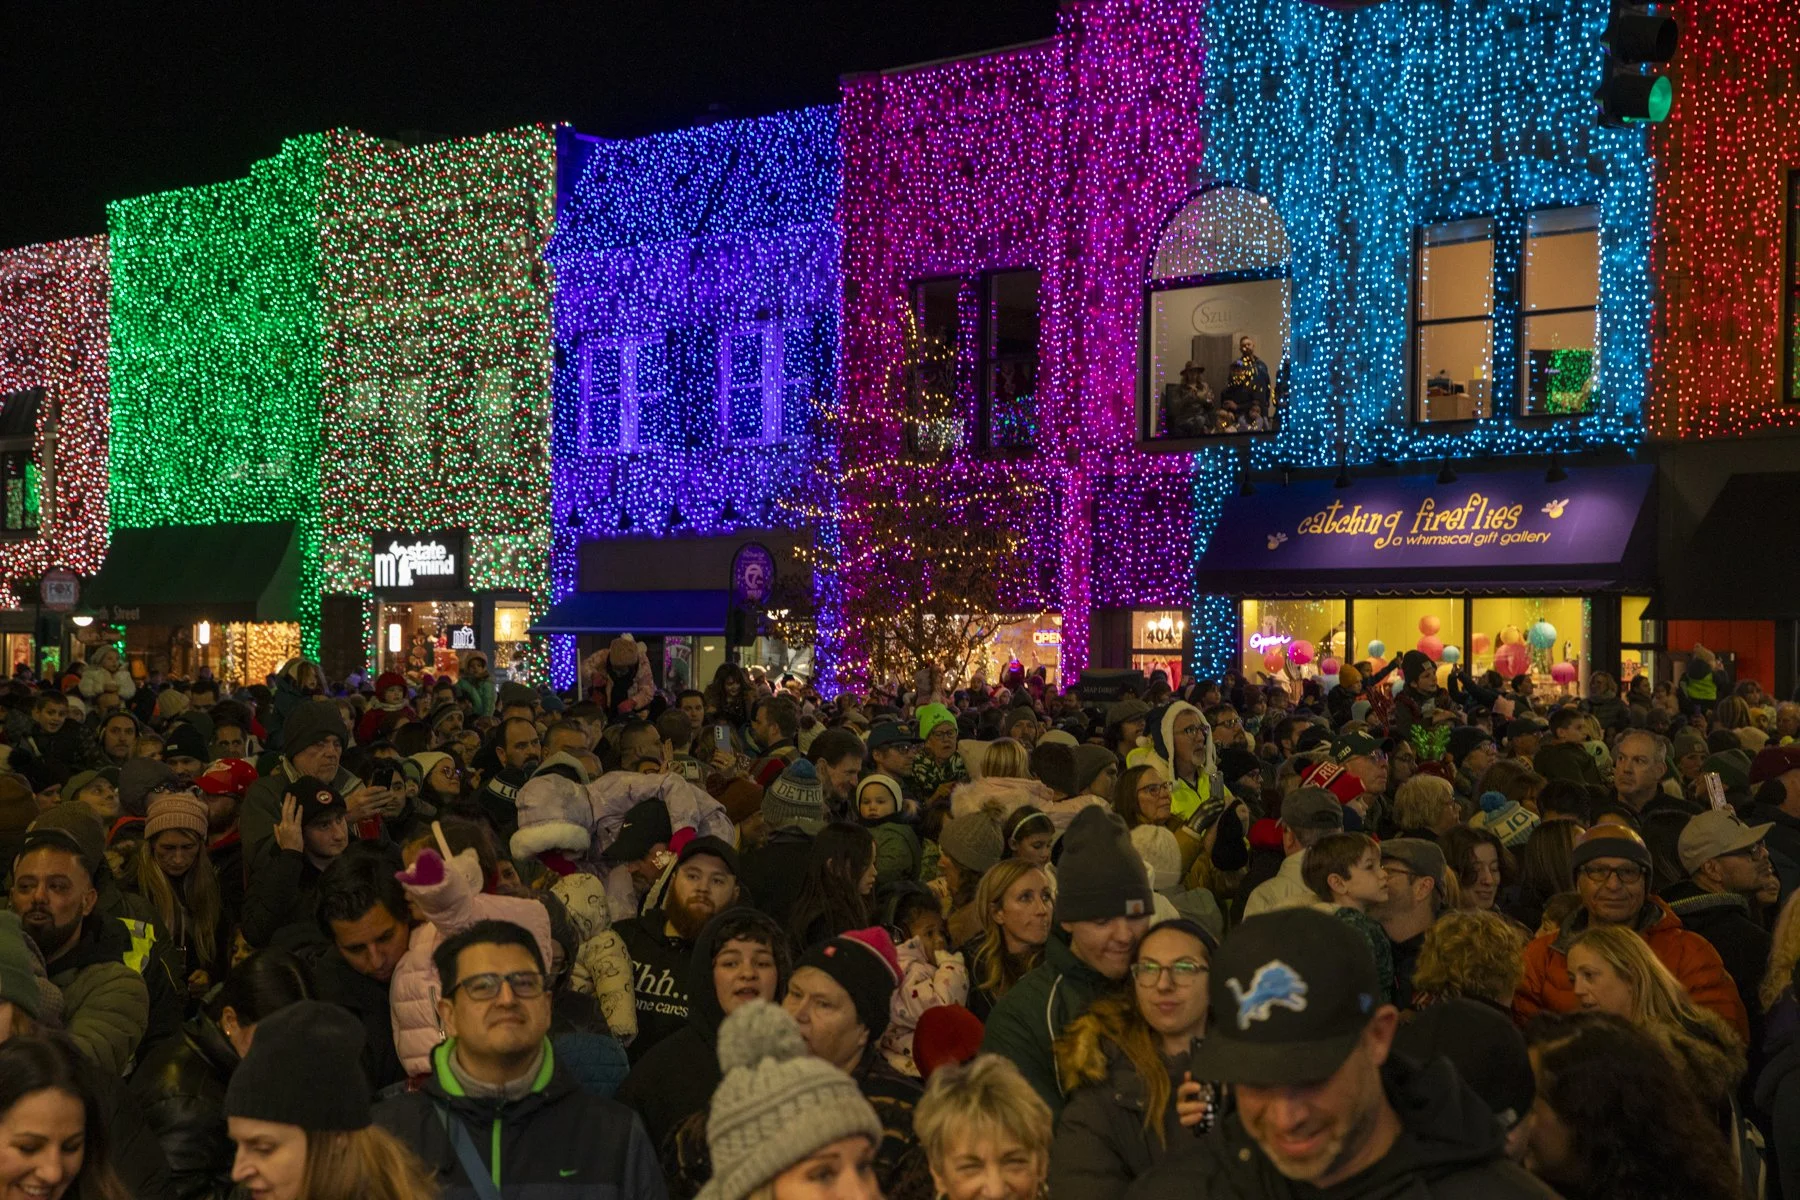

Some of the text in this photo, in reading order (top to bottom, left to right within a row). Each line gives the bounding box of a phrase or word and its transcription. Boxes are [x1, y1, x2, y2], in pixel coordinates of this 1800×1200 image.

[1297, 493, 1523, 549] catching fireflies
[1392, 530, 1551, 547] a whimsical gift gallery
[407, 541, 447, 562] state
[415, 554, 455, 576] mind
[1147, 626, 1173, 643] 404
[500, 784, 518, 798] LI
[655, 1002, 689, 1018] cares
